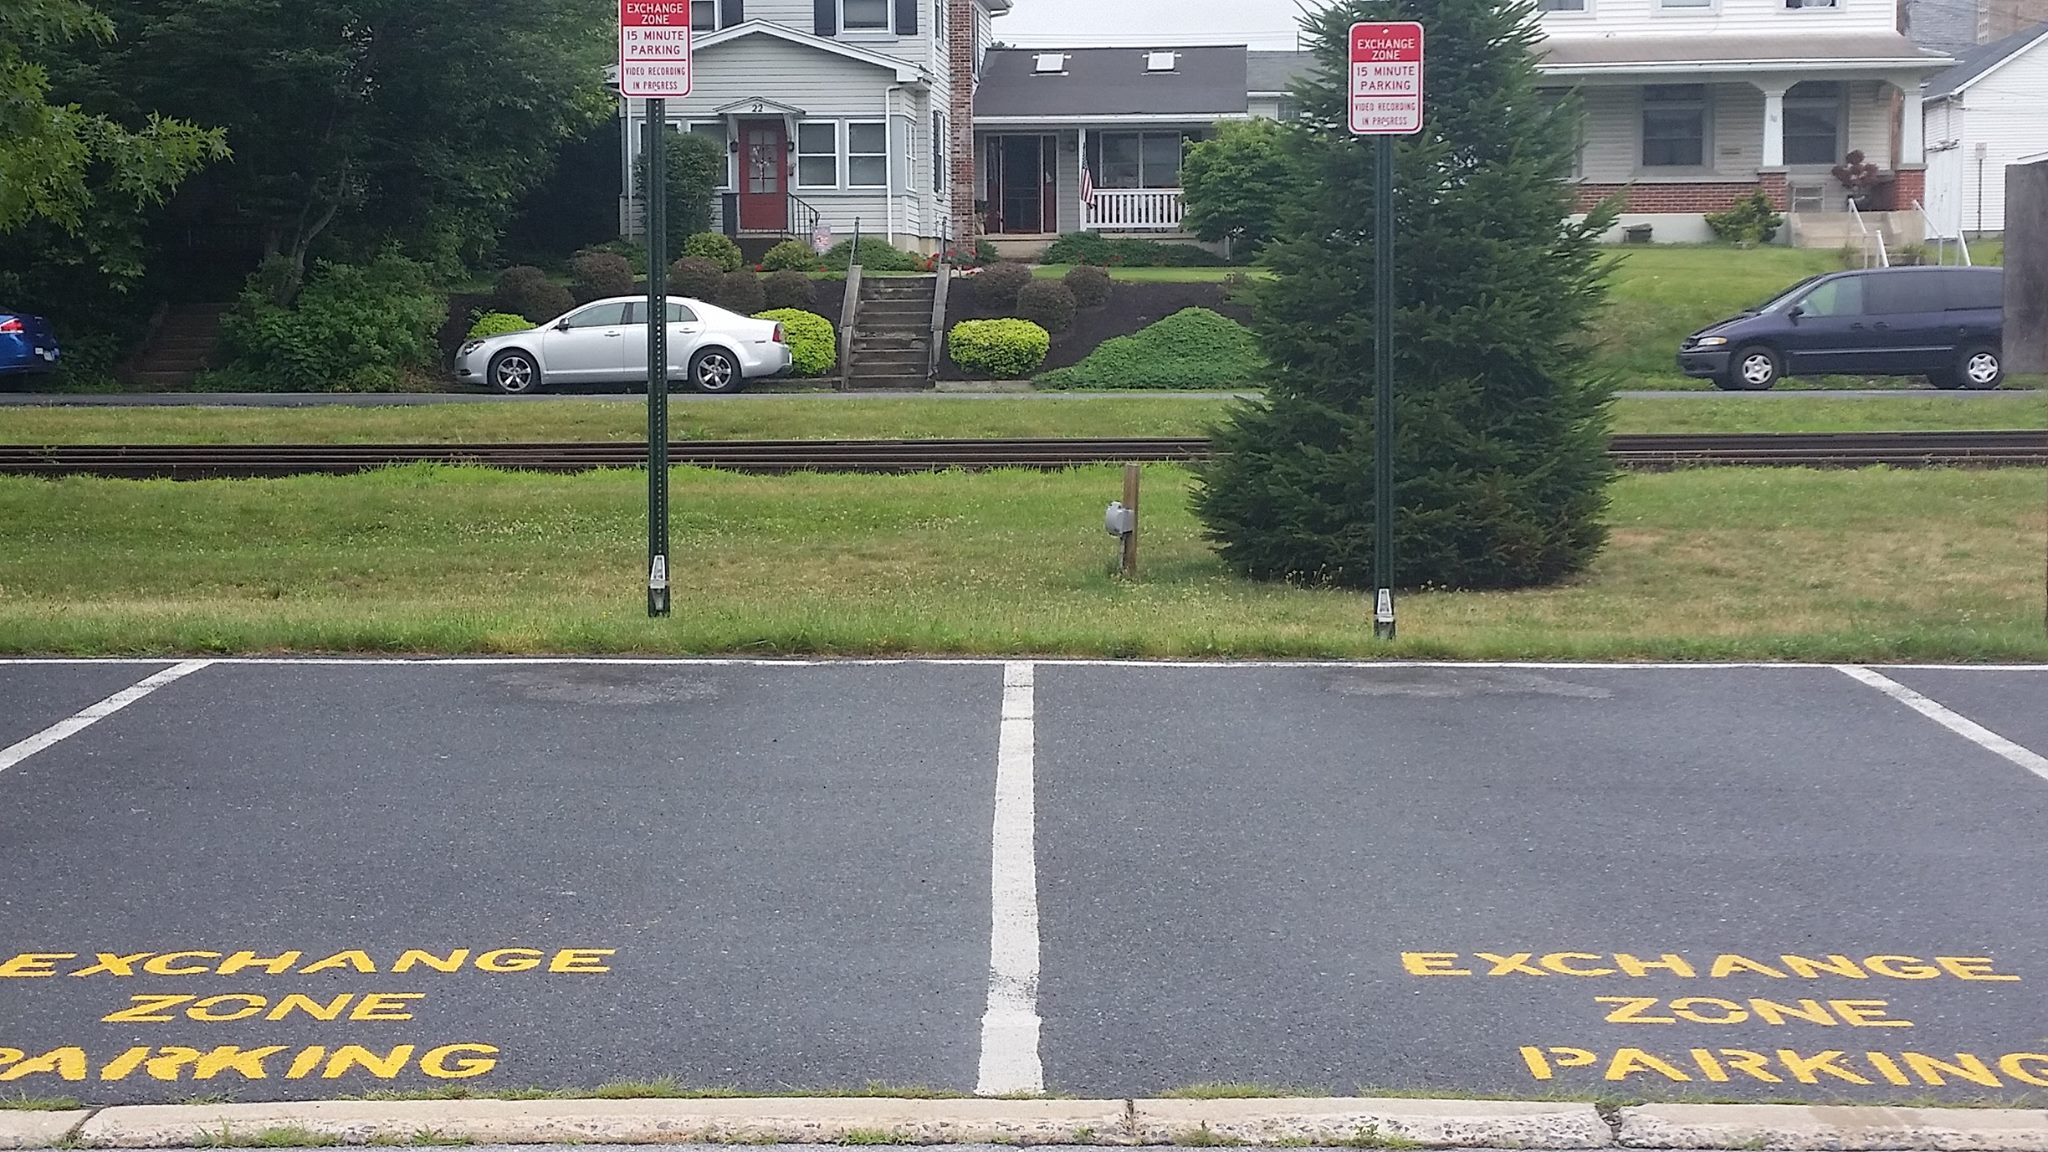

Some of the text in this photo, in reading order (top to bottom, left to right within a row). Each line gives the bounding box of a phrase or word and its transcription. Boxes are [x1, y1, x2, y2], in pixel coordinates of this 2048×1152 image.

[627, 3, 683, 13] EXCHANGE
[641, 15, 670, 24] ZONE
[627, 31, 684, 40] 15 MINUTE
[1357, 39, 1415, 49] EXCHANGE
[631, 45, 681, 55] PARKING
[1372, 50, 1401, 60] ZONE
[625, 67, 686, 75] VIDEO RECORDING
[1357, 66, 1415, 76] 15 MINUTE
[633, 81, 678, 90] IN PROGRESS
[1360, 81, 1411, 90] PARKING
[751, 104, 764, 113] 22
[1355, 102, 1416, 111] VIDEO RECORDING
[1362, 116, 1408, 125] IN PROGRESS
[0, 949, 616, 977] EXCHANGE
[1401, 952, 2021, 981] EXCHANGE
[101, 993, 426, 1022] ZONE
[1595, 997, 1914, 1027] ZONE
[1519, 1046, 2048, 1088] PARKING
